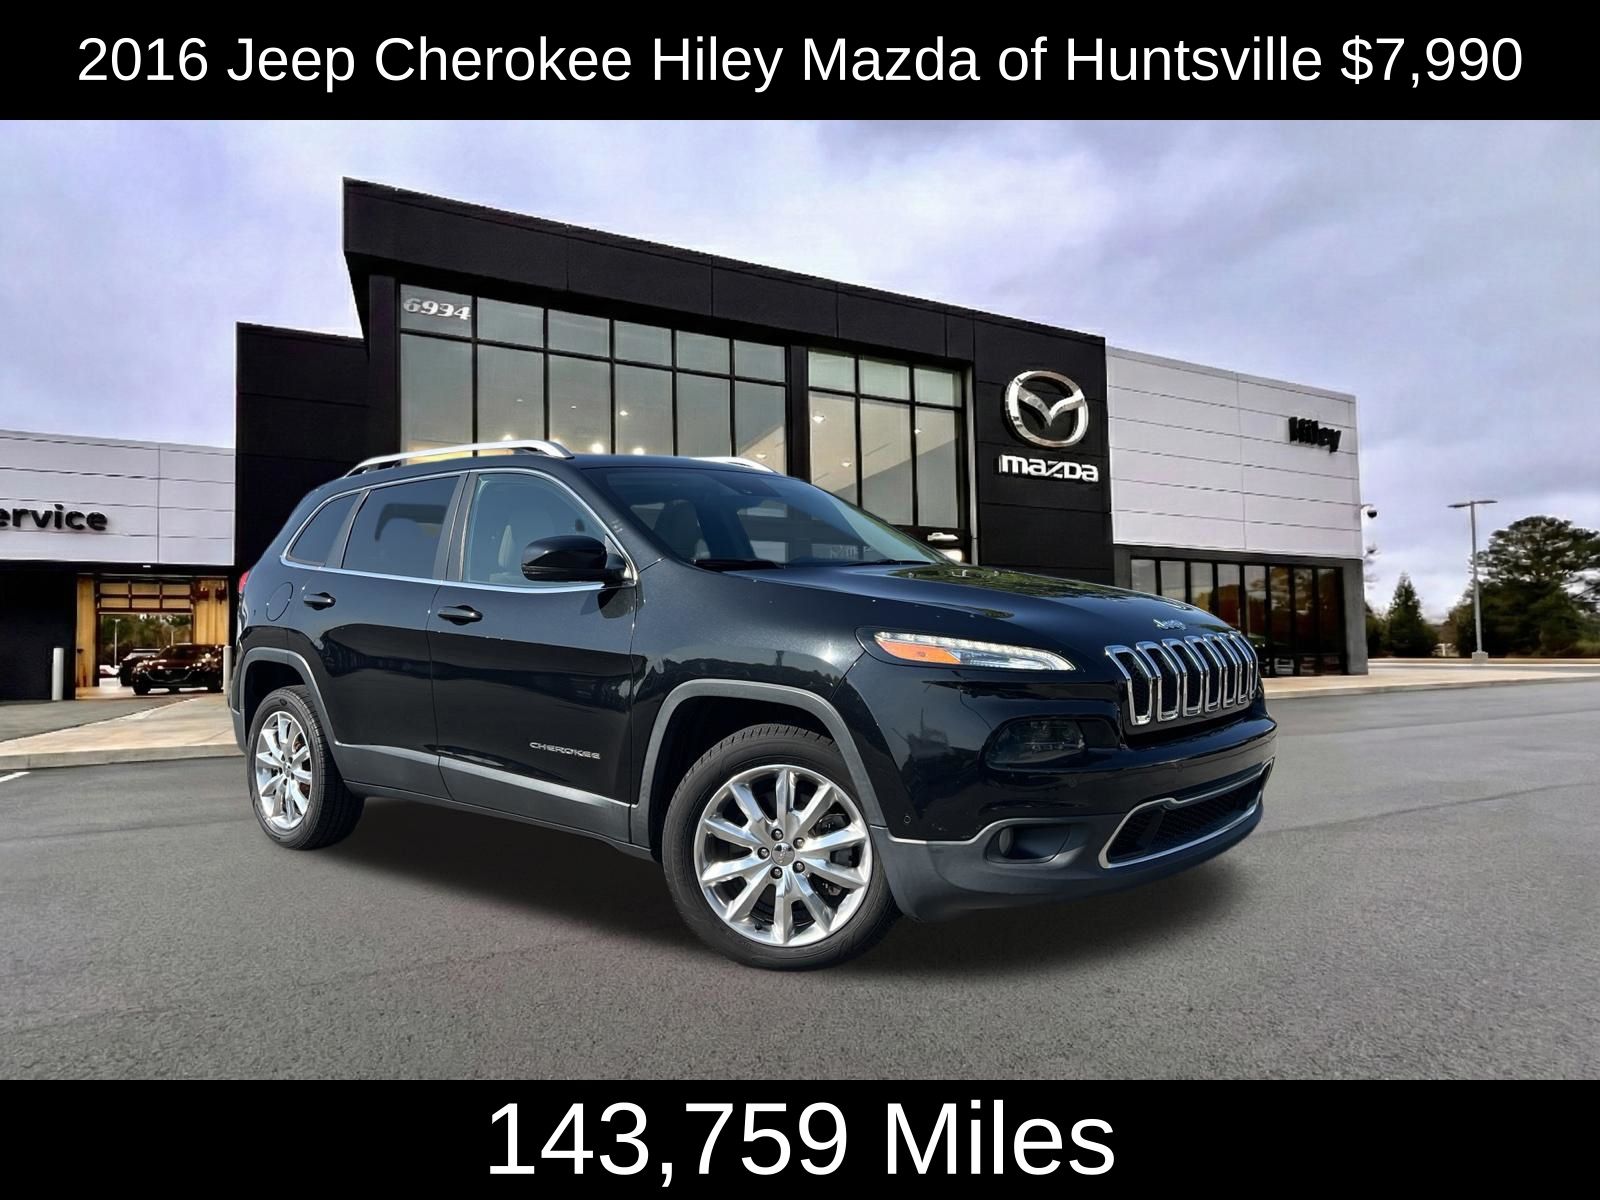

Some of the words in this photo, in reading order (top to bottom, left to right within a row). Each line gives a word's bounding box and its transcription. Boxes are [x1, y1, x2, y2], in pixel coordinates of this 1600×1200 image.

[1288, 416, 1342, 453] Hiley
[999, 454, 1099, 482] mazda
[529, 742, 601, 760] CHEROKEE
